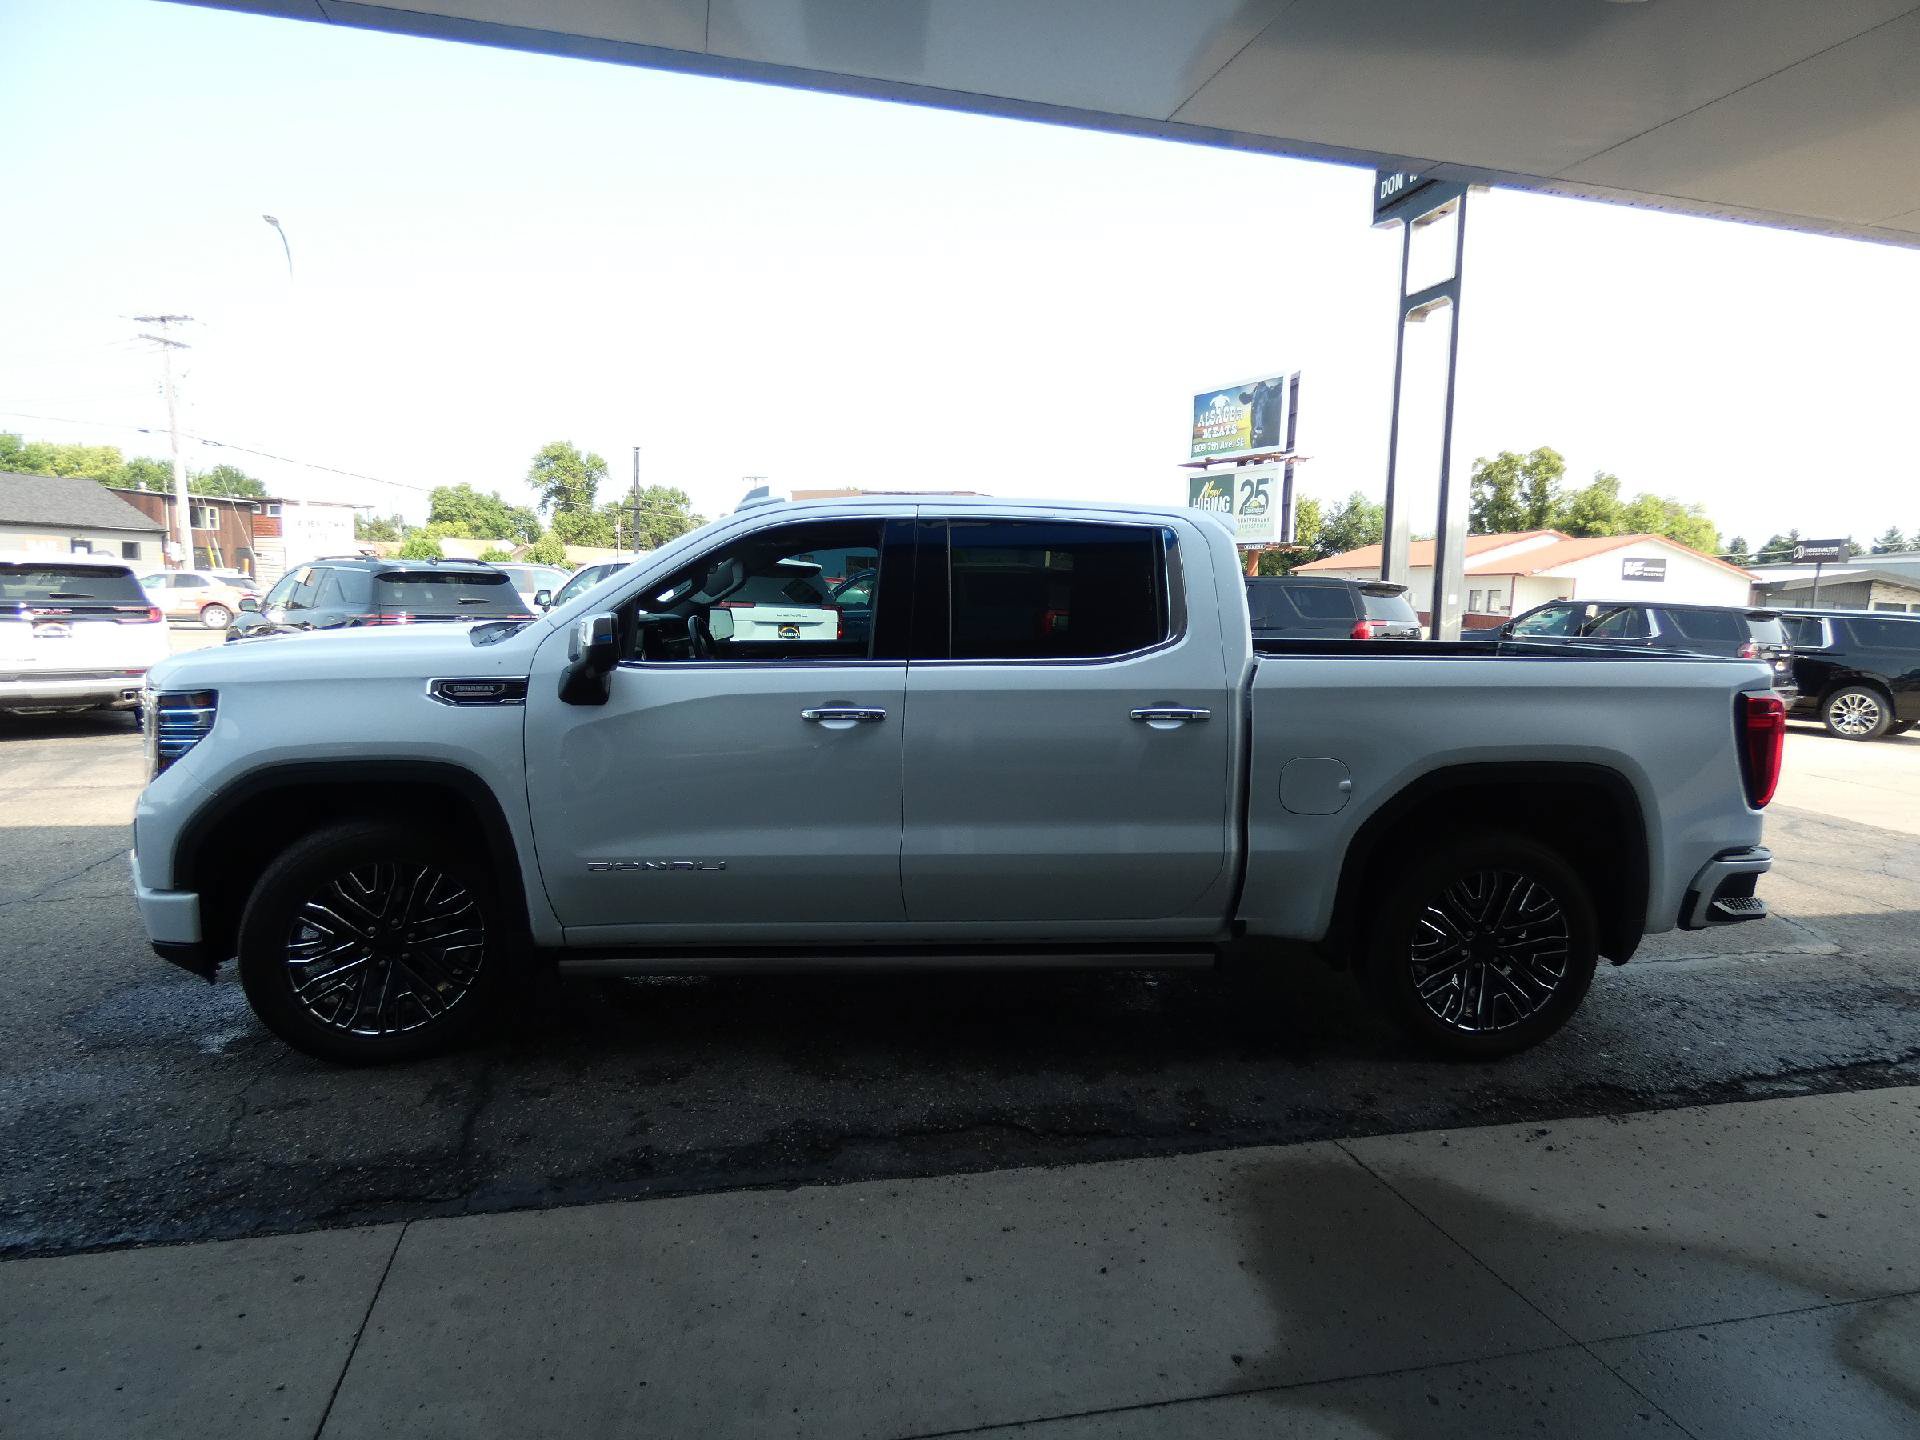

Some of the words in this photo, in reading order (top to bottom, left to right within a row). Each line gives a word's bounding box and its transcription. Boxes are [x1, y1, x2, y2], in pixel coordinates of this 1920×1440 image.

[1380, 173, 1403, 199] DON
[1202, 424, 1238, 439] MEATS
[1193, 496, 1231, 512] HIRING
[1239, 477, 1270, 516] 25
